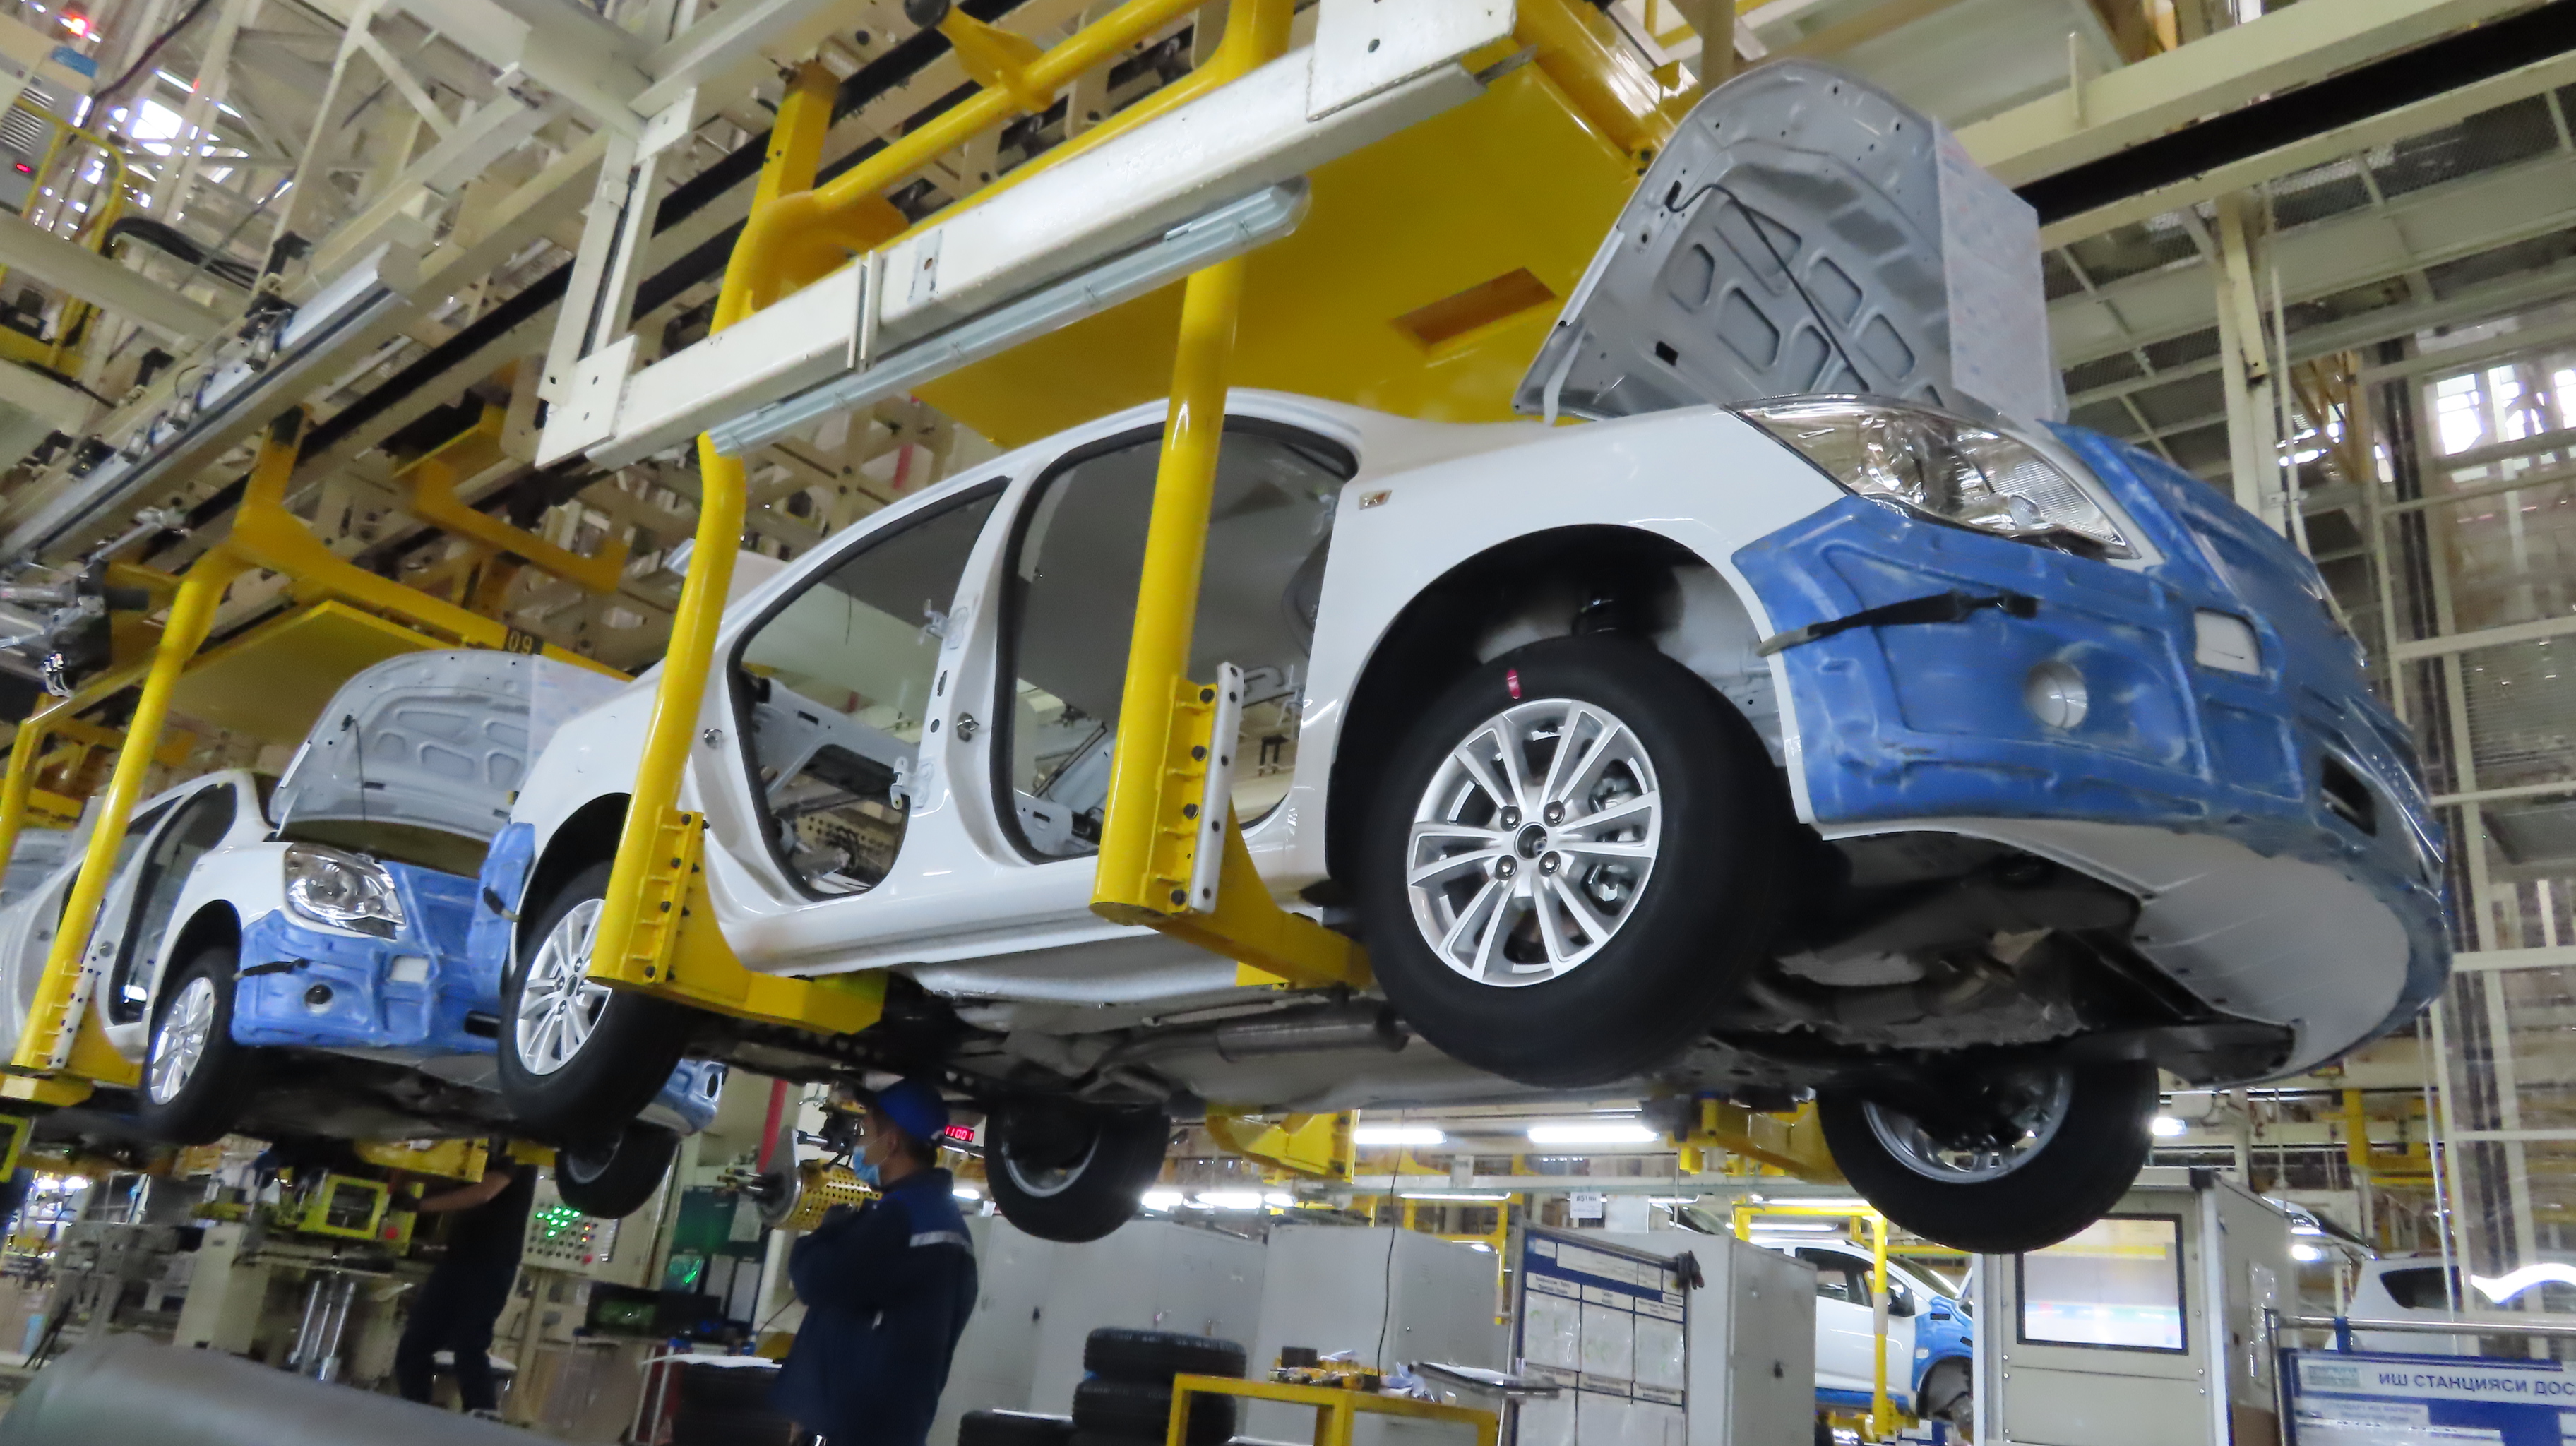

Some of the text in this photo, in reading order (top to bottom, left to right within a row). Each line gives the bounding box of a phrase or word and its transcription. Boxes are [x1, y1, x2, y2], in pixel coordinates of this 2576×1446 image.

[508, 631, 532, 655] 09
[2378, 1373, 2407, 1386] ИШ
[2414, 1375, 2527, 1392] СТАНЦИЯСИ
[2534, 1380, 2575, 1396] ДОС
